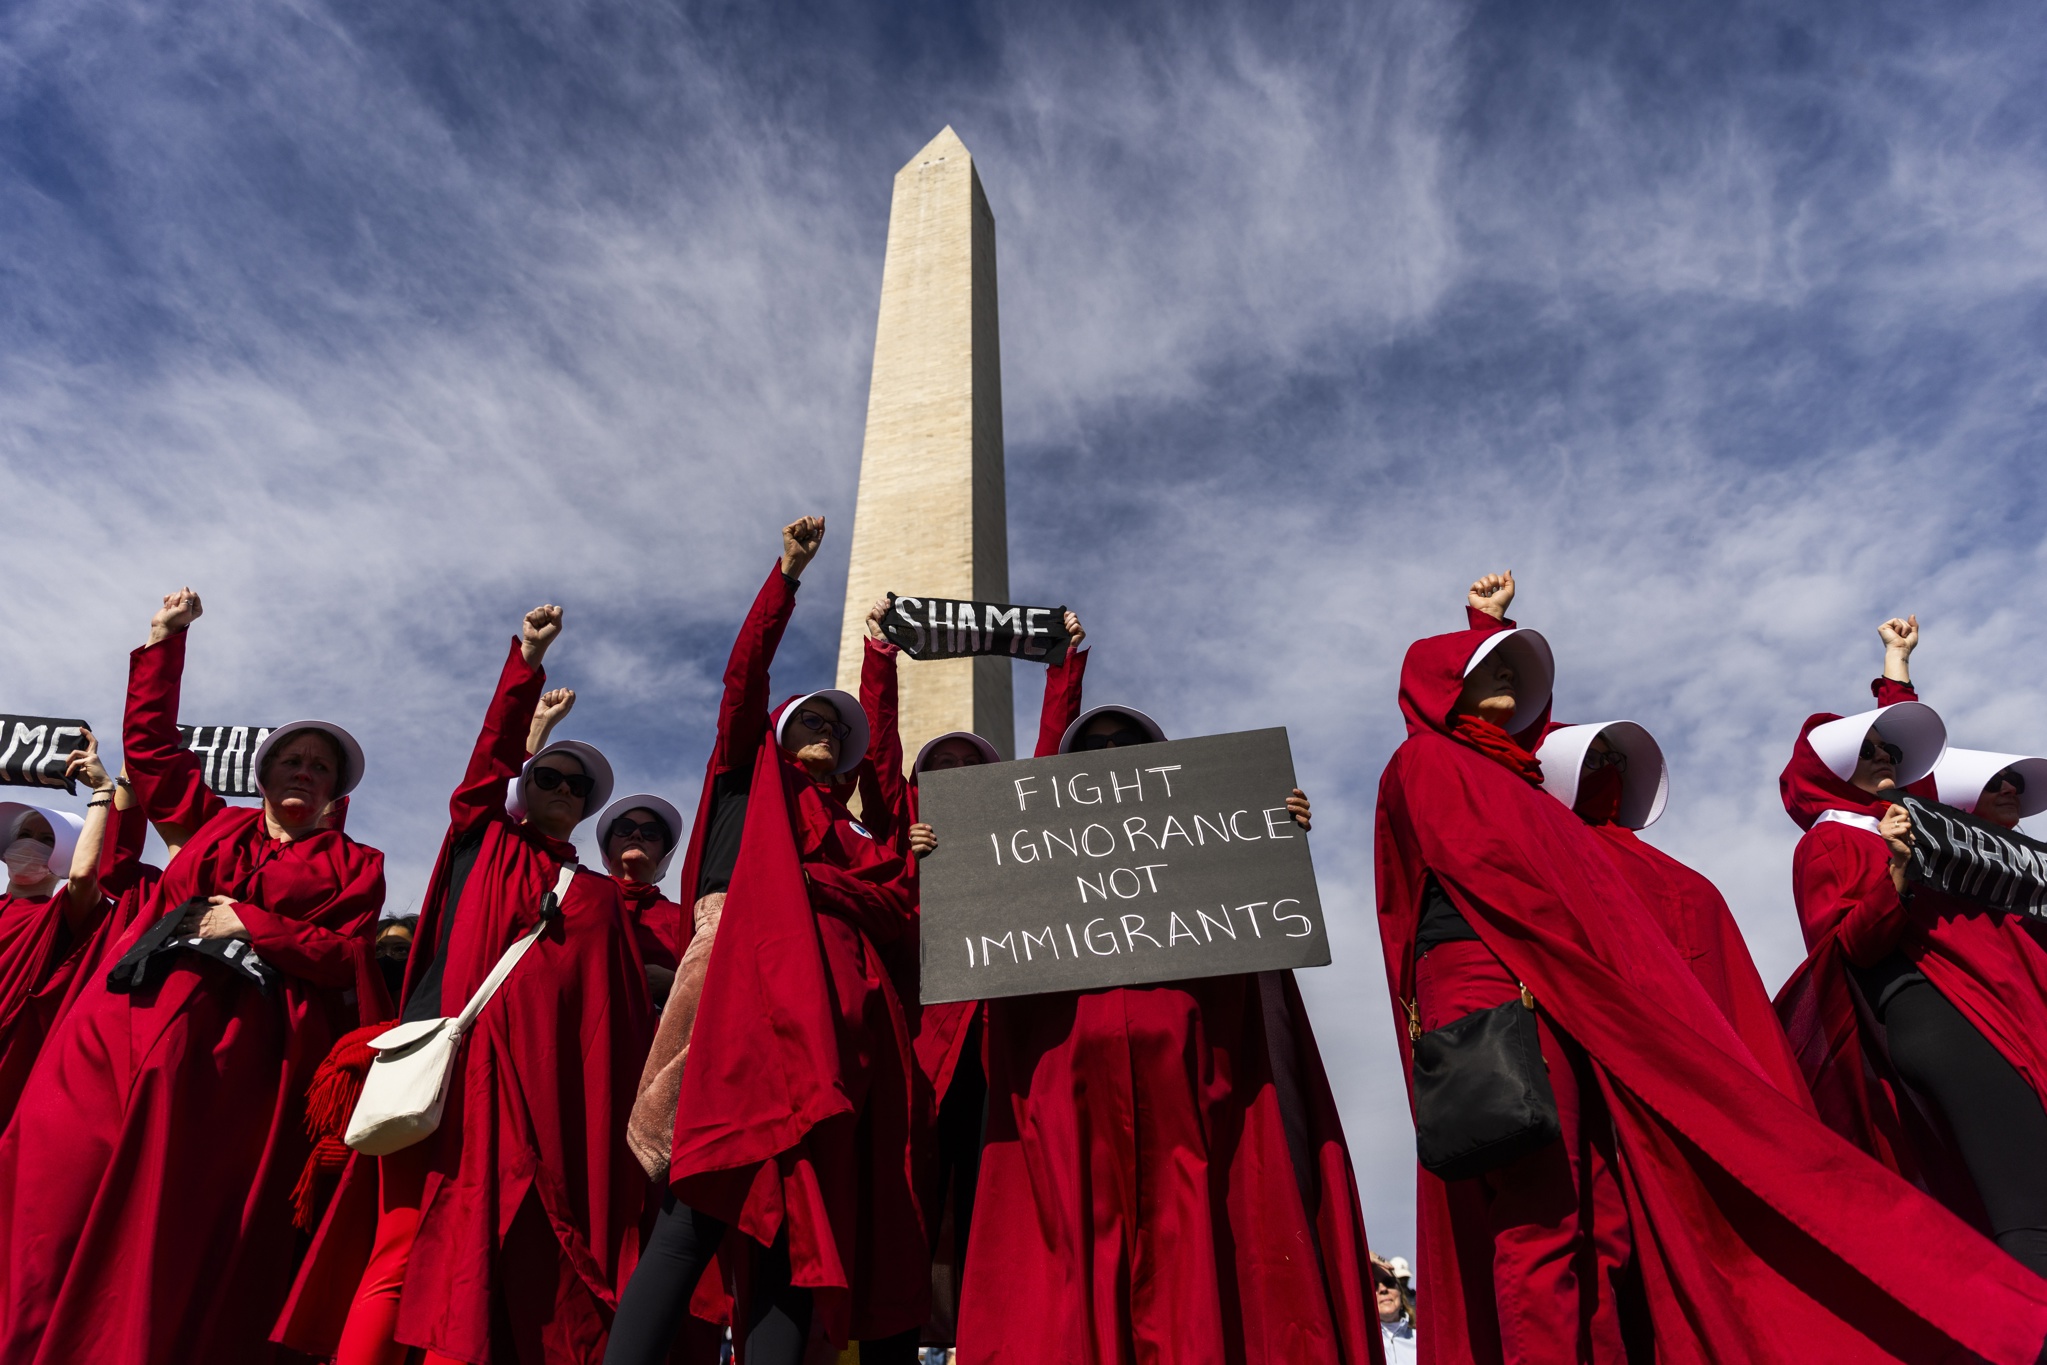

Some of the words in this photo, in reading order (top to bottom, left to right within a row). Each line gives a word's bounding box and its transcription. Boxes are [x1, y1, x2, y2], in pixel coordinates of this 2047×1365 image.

[889, 596, 1050, 655] SHAME
[0, 720, 82, 788] ME
[176, 726, 270, 793] HA
[1014, 764, 1182, 811] FIGHT
[990, 807, 1294, 865] IGNORANCE
[1077, 863, 1168, 903] NOT
[965, 898, 1312, 968] IMMIGRANTS
